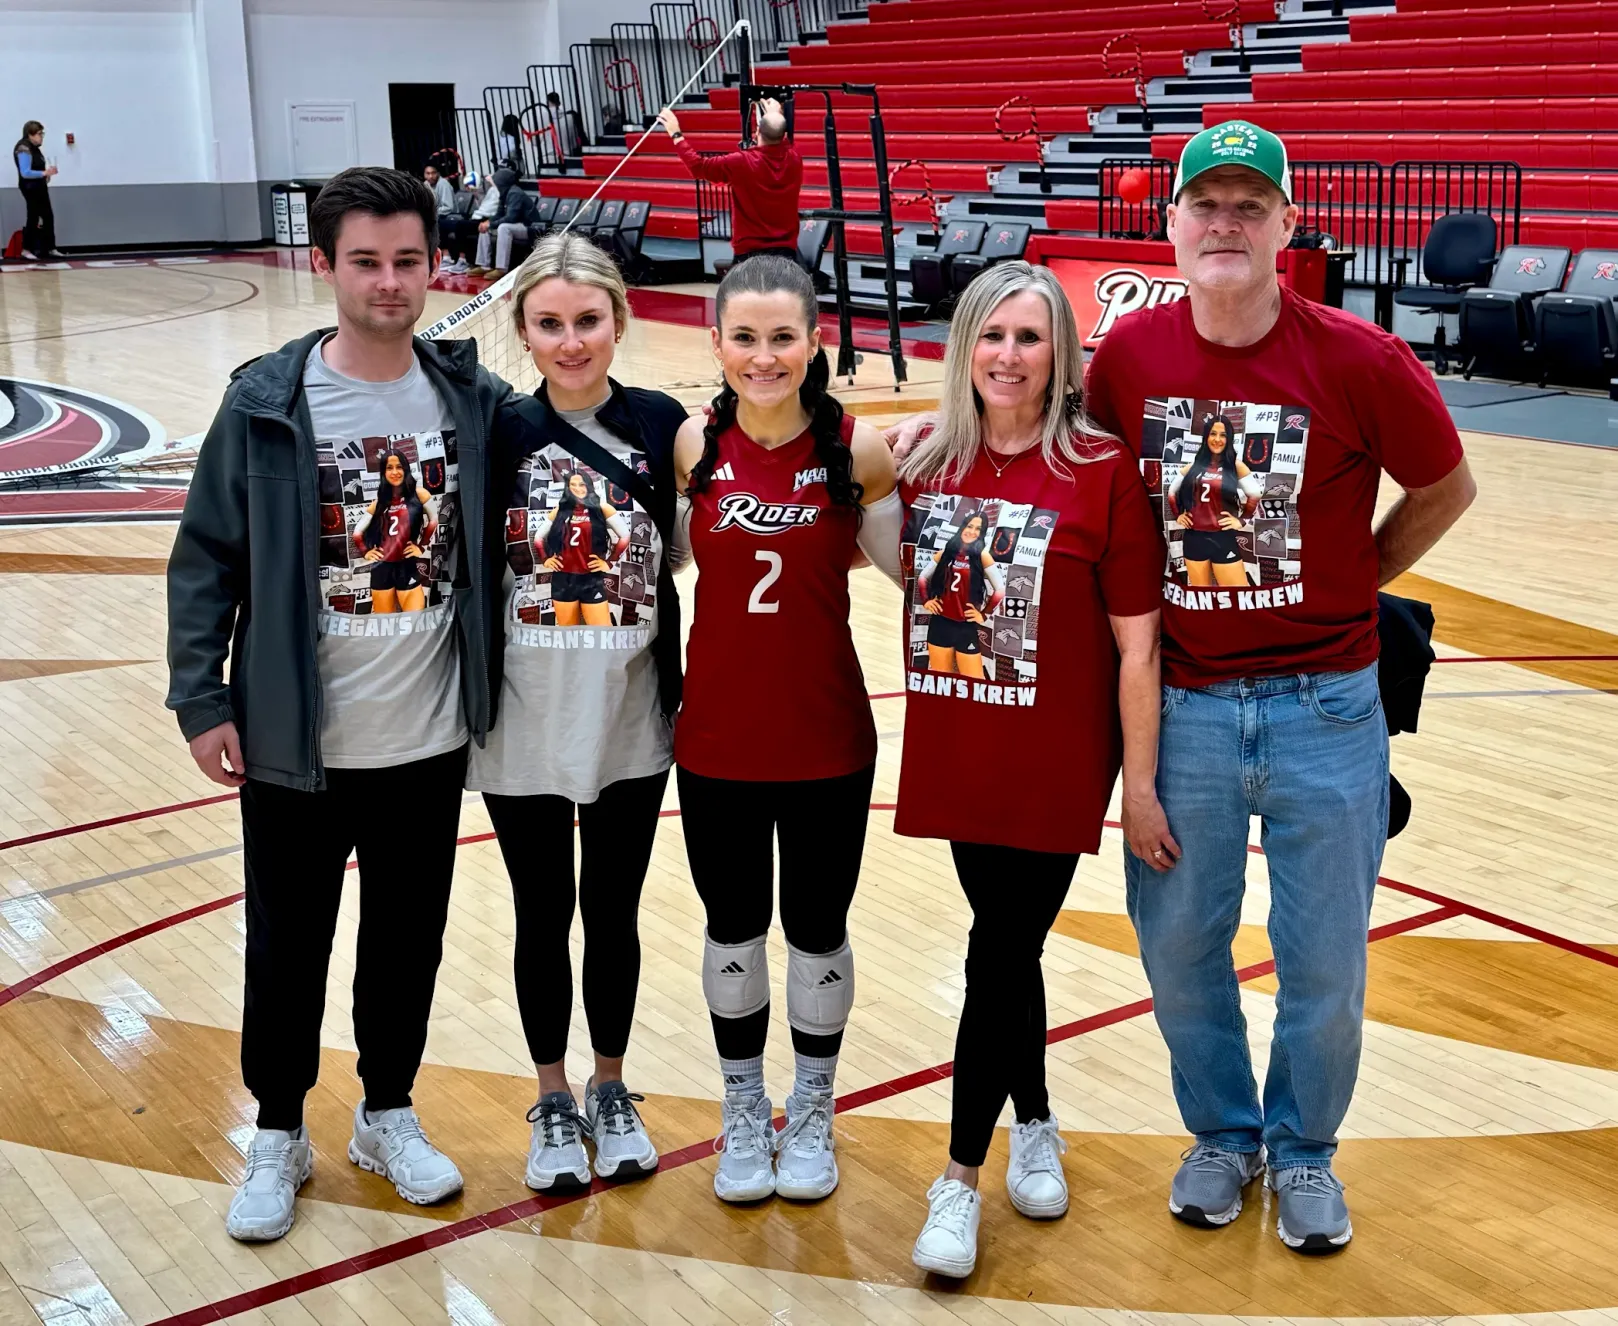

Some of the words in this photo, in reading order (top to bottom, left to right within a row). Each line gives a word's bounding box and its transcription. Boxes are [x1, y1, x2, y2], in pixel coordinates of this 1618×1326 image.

[1211, 124, 1258, 141] MASTERS
[447, 290, 493, 326] BRONCS
[1256, 411, 1280, 422] #P3
[424, 436, 443, 449] #P3
[1200, 484, 1210, 502] 2
[709, 491, 820, 536] RIDER
[388, 515, 399, 536] 2
[569, 527, 581, 546] 2
[748, 550, 783, 613] 2
[951, 572, 962, 592] 2
[1237, 582, 1304, 611] KREW
[600, 629, 650, 650] KREW
[908, 672, 969, 700] GAN'S
[972, 682, 1037, 706] KREW
